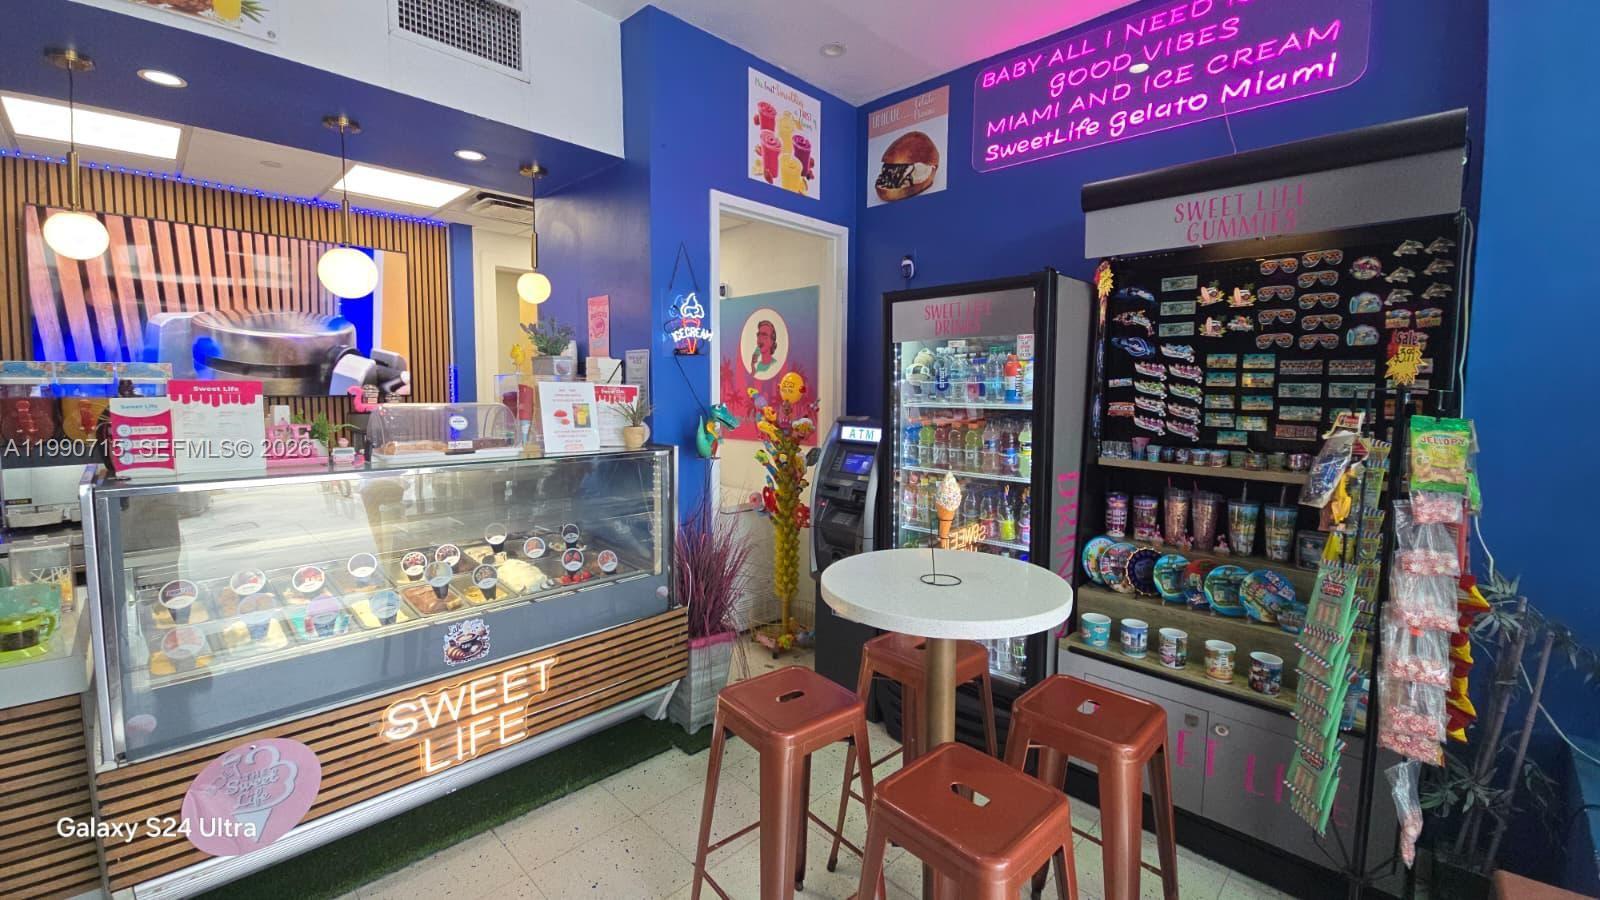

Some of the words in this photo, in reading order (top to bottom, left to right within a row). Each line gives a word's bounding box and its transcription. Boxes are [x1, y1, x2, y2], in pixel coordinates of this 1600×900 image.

[982, 54, 1043, 88] BABY
[1048, 39, 1096, 67] ALL
[1106, 30, 1112, 48] I
[1126, 0, 1213, 41] NEED
[1144, 17, 1240, 61] VIBES
[986, 101, 1060, 137] MIAMI
[1068, 83, 1131, 113] AND
[1144, 64, 1194, 94] ICE
[1207, 19, 1341, 74] CREAM
[1221, 52, 1337, 104] Miami
[1174, 192, 1245, 224] SWEET
[1186, 207, 1297, 242] GUMMIES
[924, 301, 962, 320] SWEET
[849, 429, 875, 441] ATM
[385, 657, 557, 740] SWEET
[424, 706, 526, 773] LIFE
